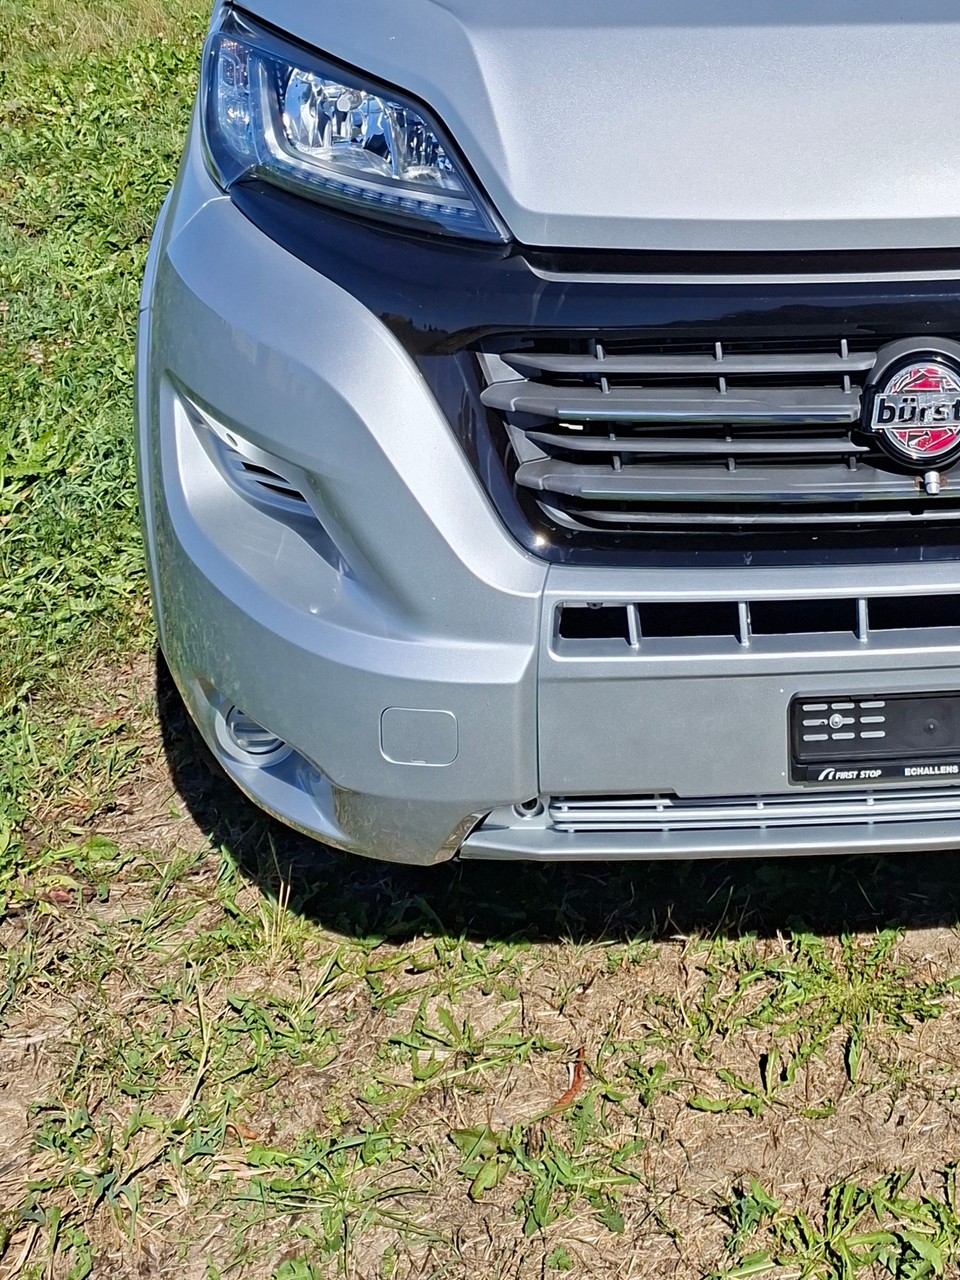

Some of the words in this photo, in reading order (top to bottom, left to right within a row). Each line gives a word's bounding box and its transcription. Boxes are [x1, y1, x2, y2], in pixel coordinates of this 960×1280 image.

[835, 771, 859, 780] FIRST
[859, 770, 882, 779] STOP
[904, 765, 959, 776] ECHALLENS
